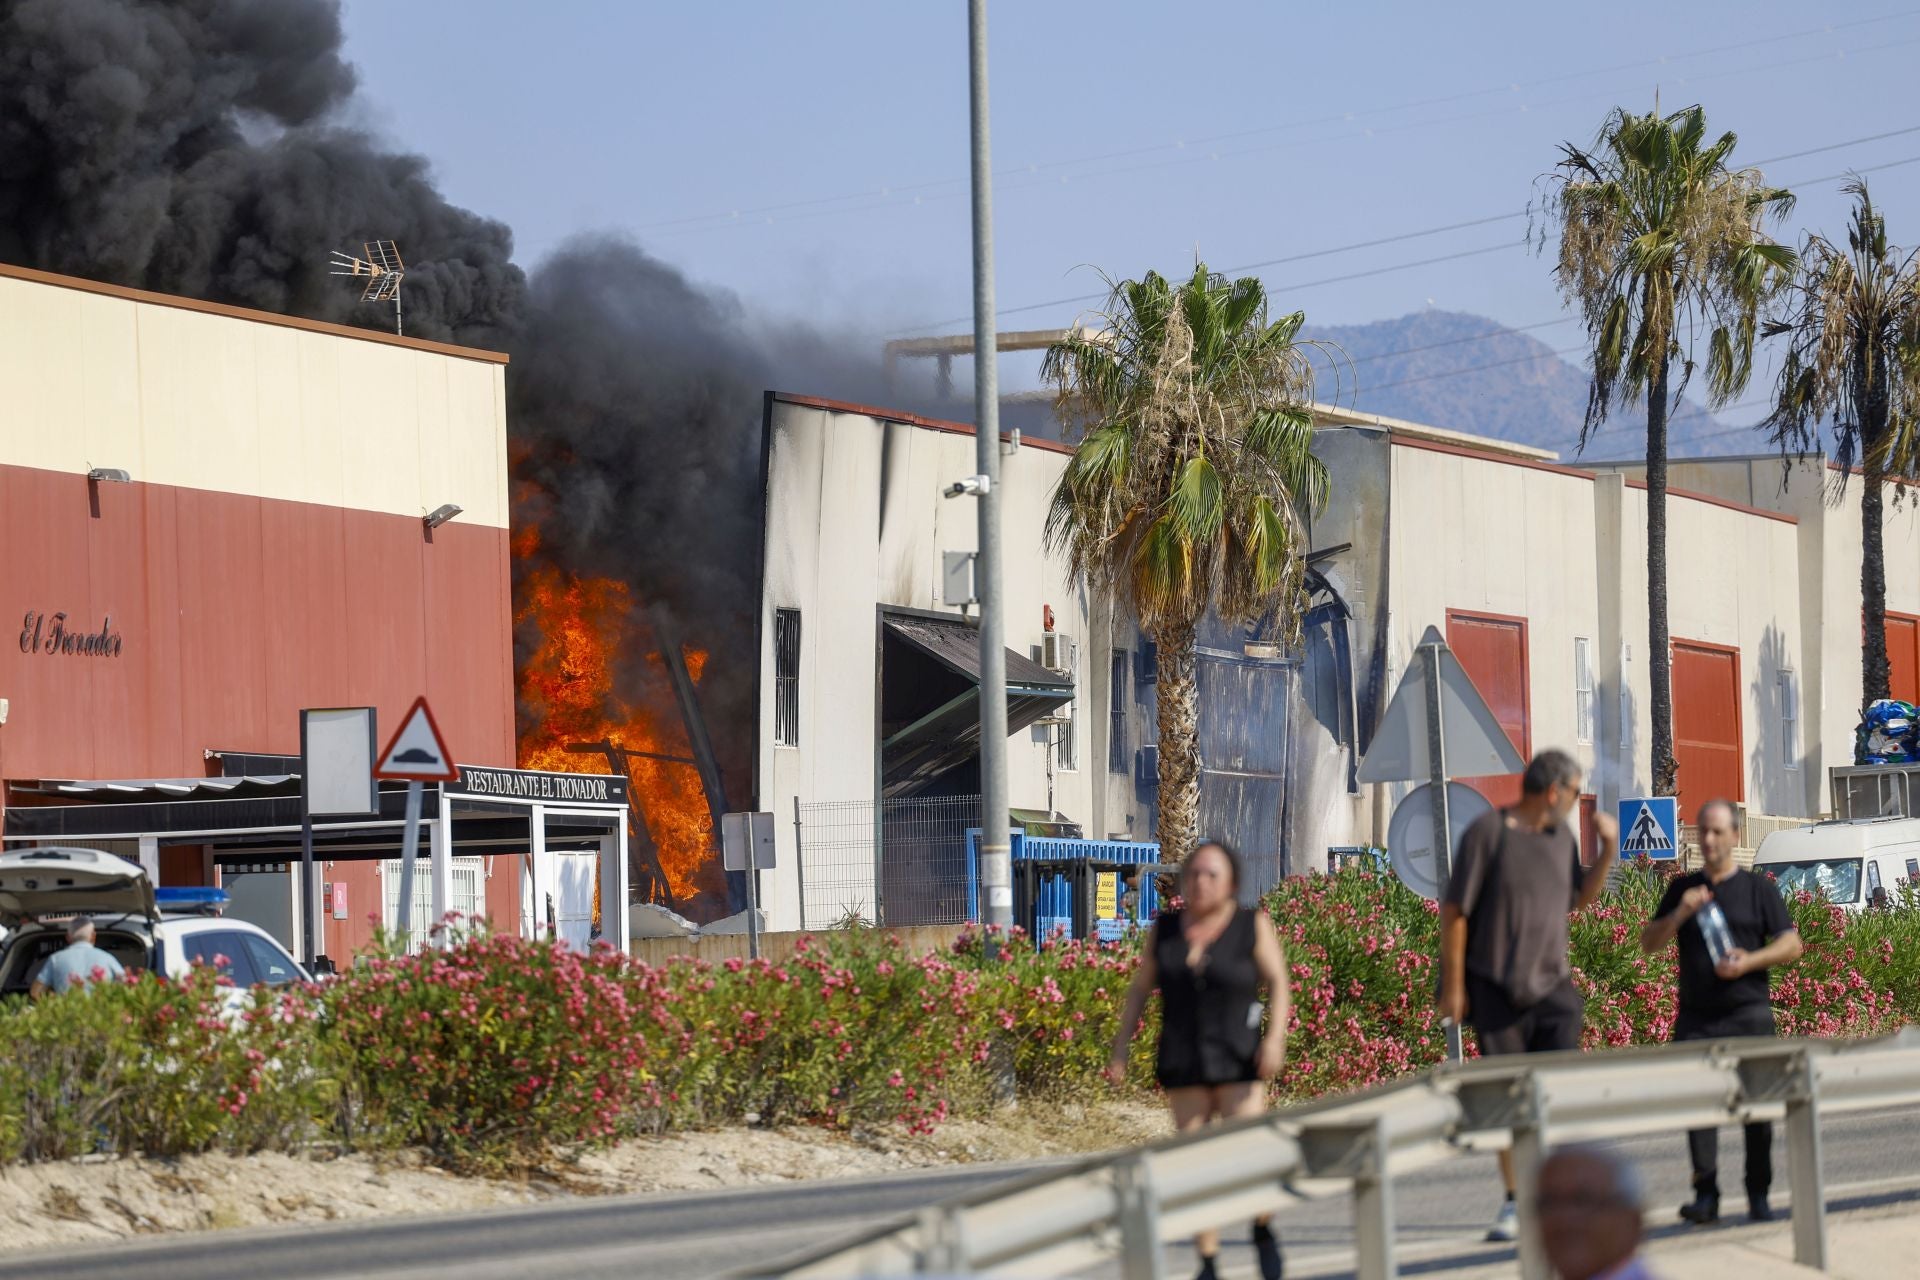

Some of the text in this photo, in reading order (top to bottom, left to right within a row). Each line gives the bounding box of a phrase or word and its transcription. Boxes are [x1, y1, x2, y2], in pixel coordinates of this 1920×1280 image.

[20, 610, 122, 657] El Trovador
[466, 771, 608, 800] RESTAURANTE EL TROVADOR
